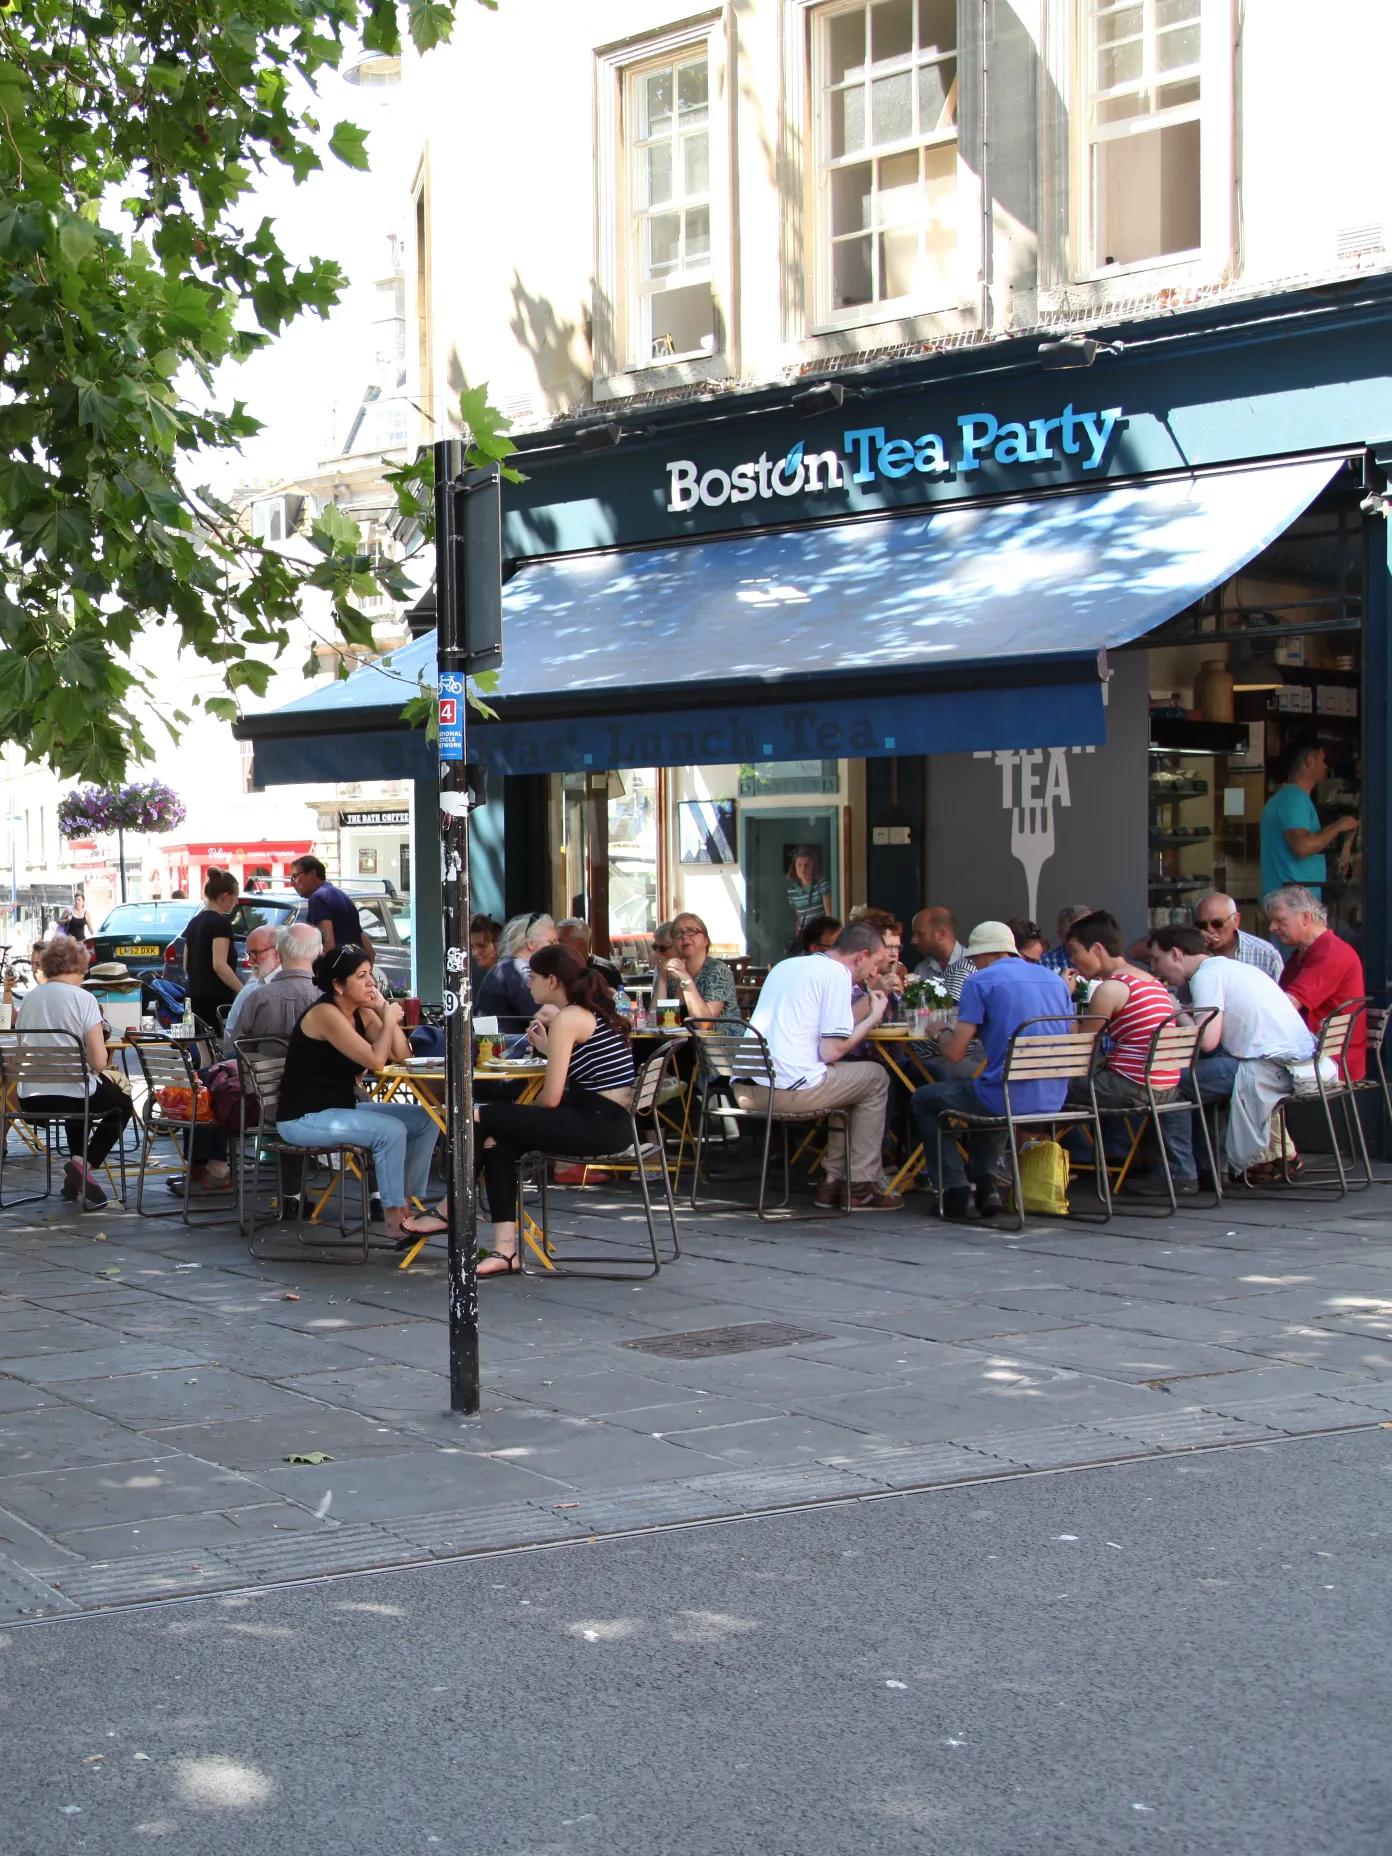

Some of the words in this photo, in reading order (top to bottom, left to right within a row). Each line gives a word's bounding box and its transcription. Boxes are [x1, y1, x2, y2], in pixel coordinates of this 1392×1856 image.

[666, 450, 844, 513] Boston
[843, 426, 950, 484] Tea
[957, 402, 1123, 471] Party
[440, 704, 452, 719] 4
[994, 753, 1072, 809] TEA
[348, 814, 362, 823] THE
[362, 813, 381, 823] BATH
[382, 812, 410, 823] COFFEE
